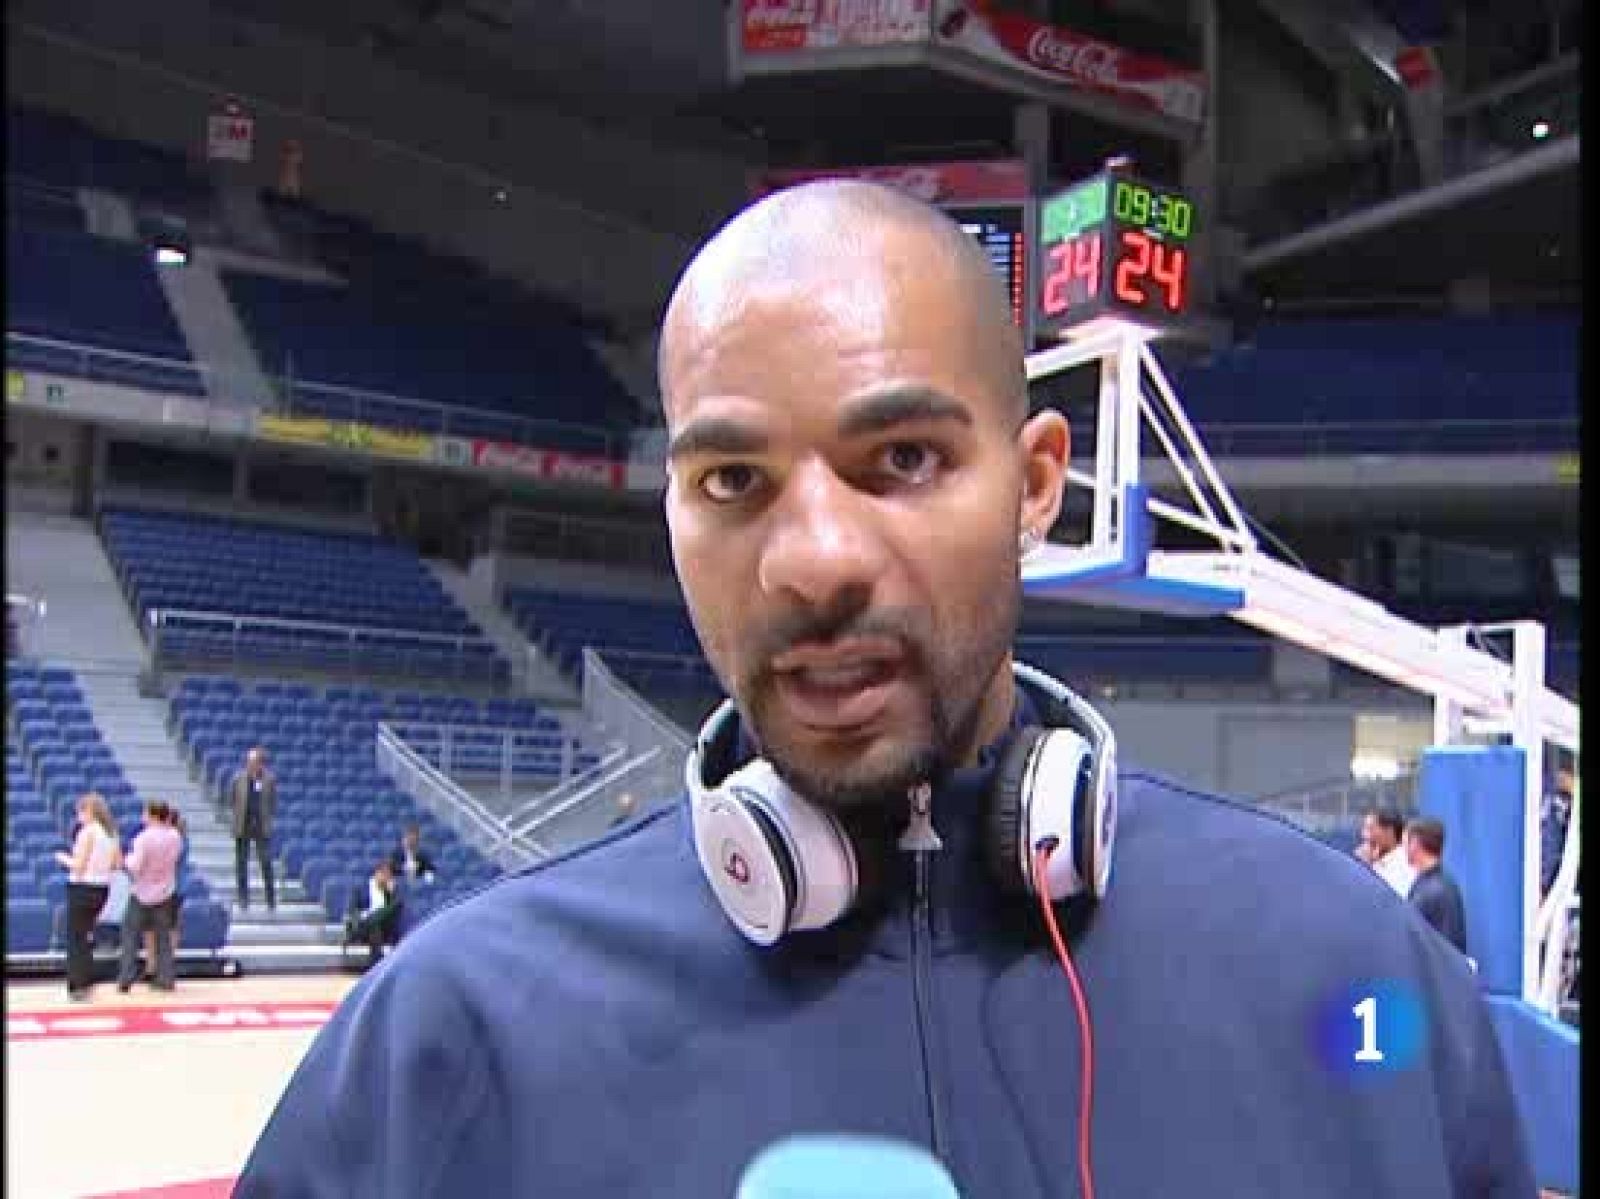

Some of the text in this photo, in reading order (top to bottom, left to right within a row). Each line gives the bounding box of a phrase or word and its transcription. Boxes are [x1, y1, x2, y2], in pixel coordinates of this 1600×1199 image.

[1114, 182, 1191, 237] 09:30
[1043, 233, 1101, 314] 24
[1116, 232, 1184, 309] 24
